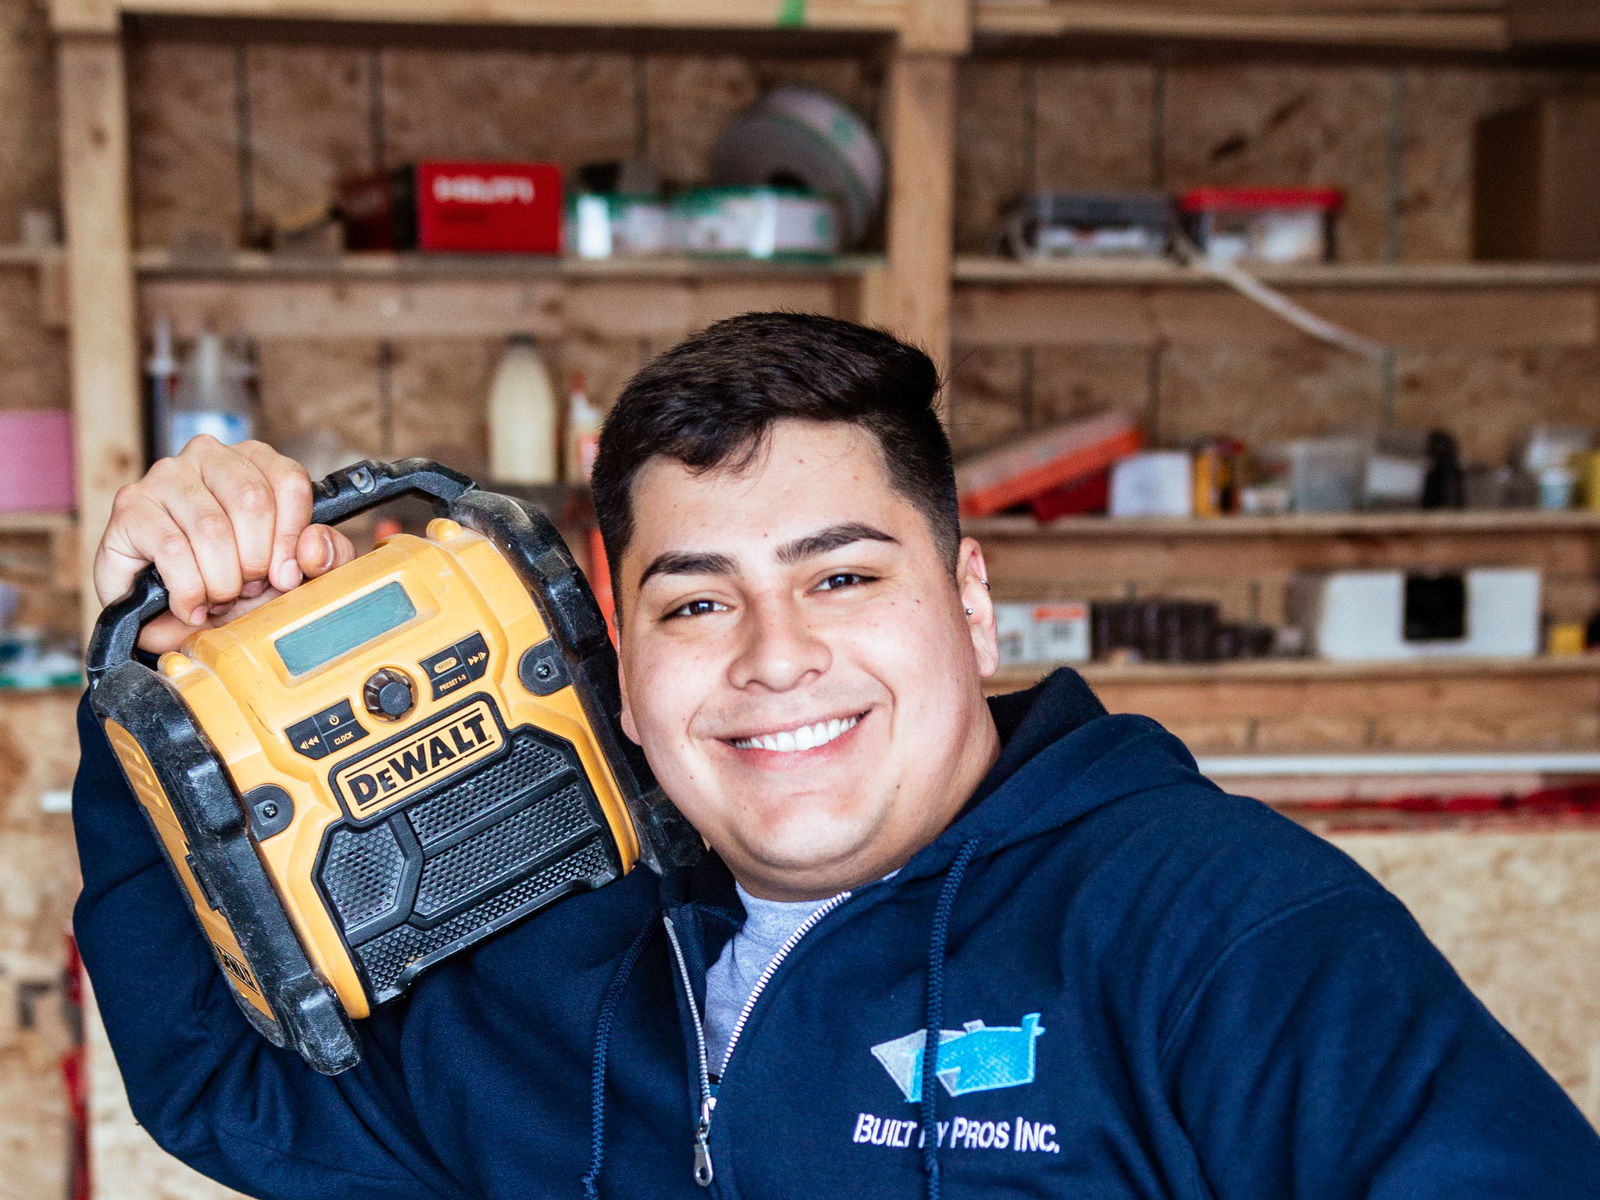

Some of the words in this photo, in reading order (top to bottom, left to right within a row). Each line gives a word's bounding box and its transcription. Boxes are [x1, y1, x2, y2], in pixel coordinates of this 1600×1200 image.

[334, 731, 355, 746] CLOCK
[347, 712, 488, 807] DEWALT
[853, 1112, 917, 1148] BUILT
[950, 1116, 1010, 1149] PROS
[1013, 1116, 1060, 1154] INC.
